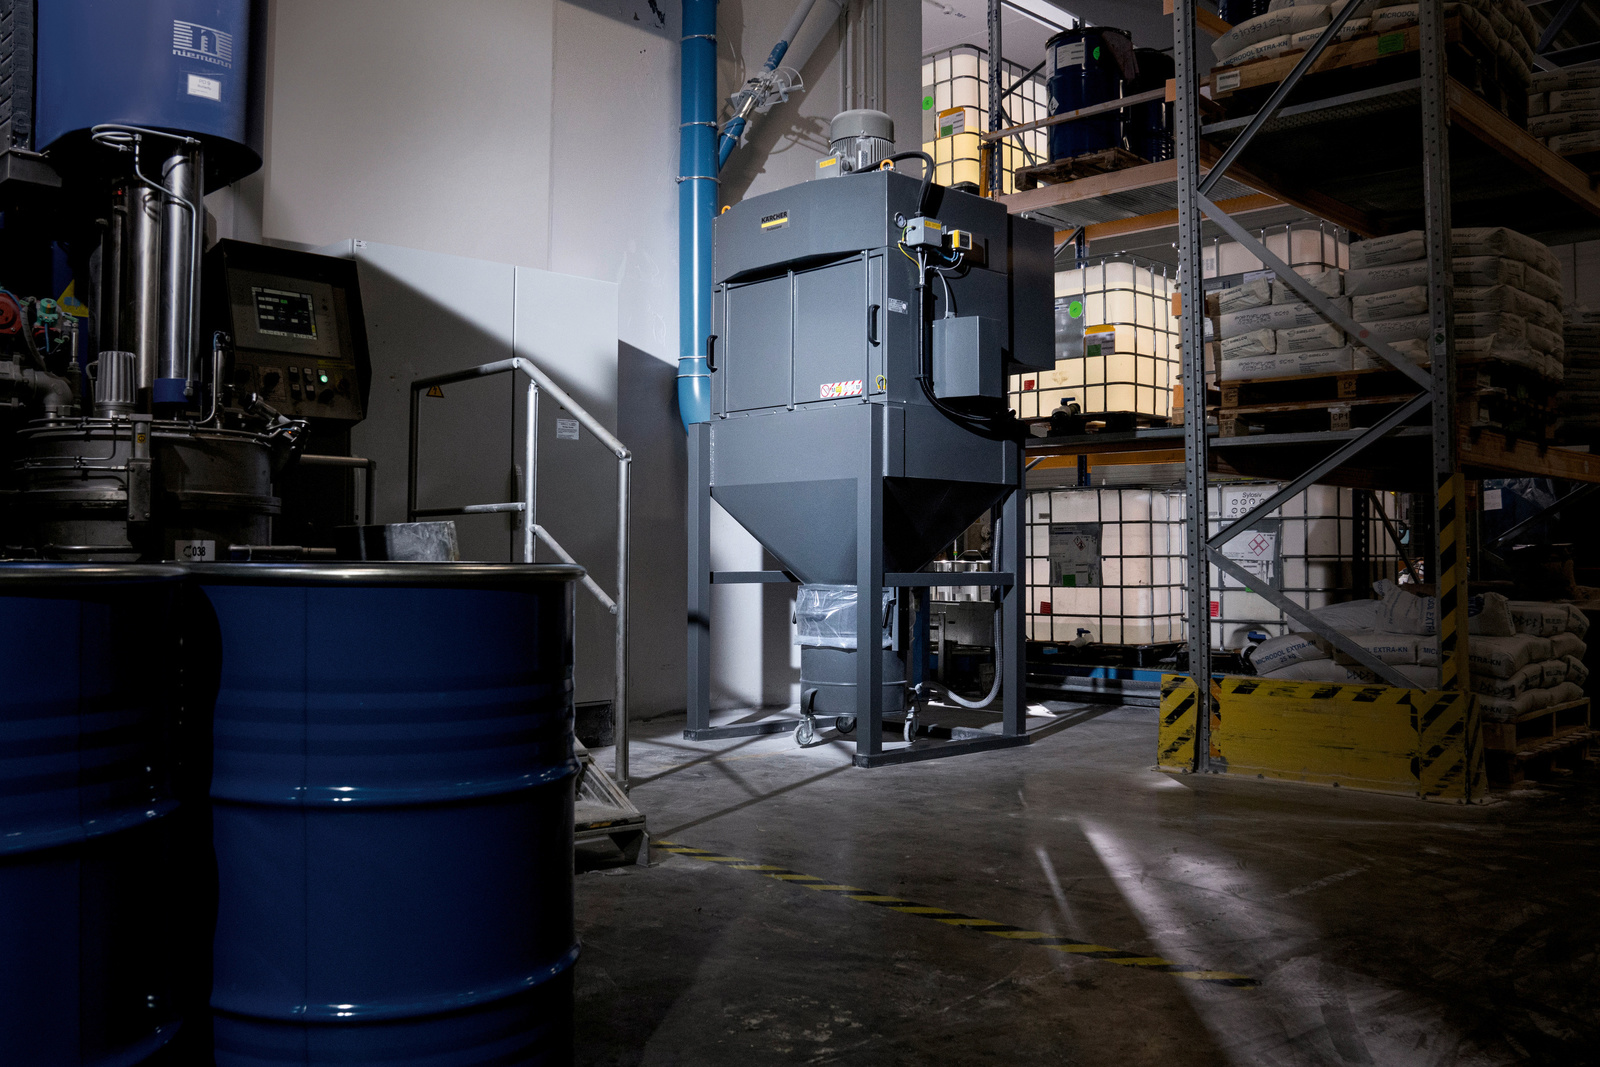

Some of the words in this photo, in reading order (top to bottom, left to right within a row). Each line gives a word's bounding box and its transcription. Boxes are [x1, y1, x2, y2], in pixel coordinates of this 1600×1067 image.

[1379, 11, 1416, 19] MICRODOL
[172, 49, 232, 69] niemann
[1223, 50, 1255, 66] MICRODOL
[1255, 41, 1289, 54] EXTRA-KN
[1332, 413, 1349, 421] CP1
[1255, 650, 1285, 666] MICRODOL
[1285, 639, 1316, 654] EXTRA-KN
[1373, 646, 1409, 654] EXTRA-KN
